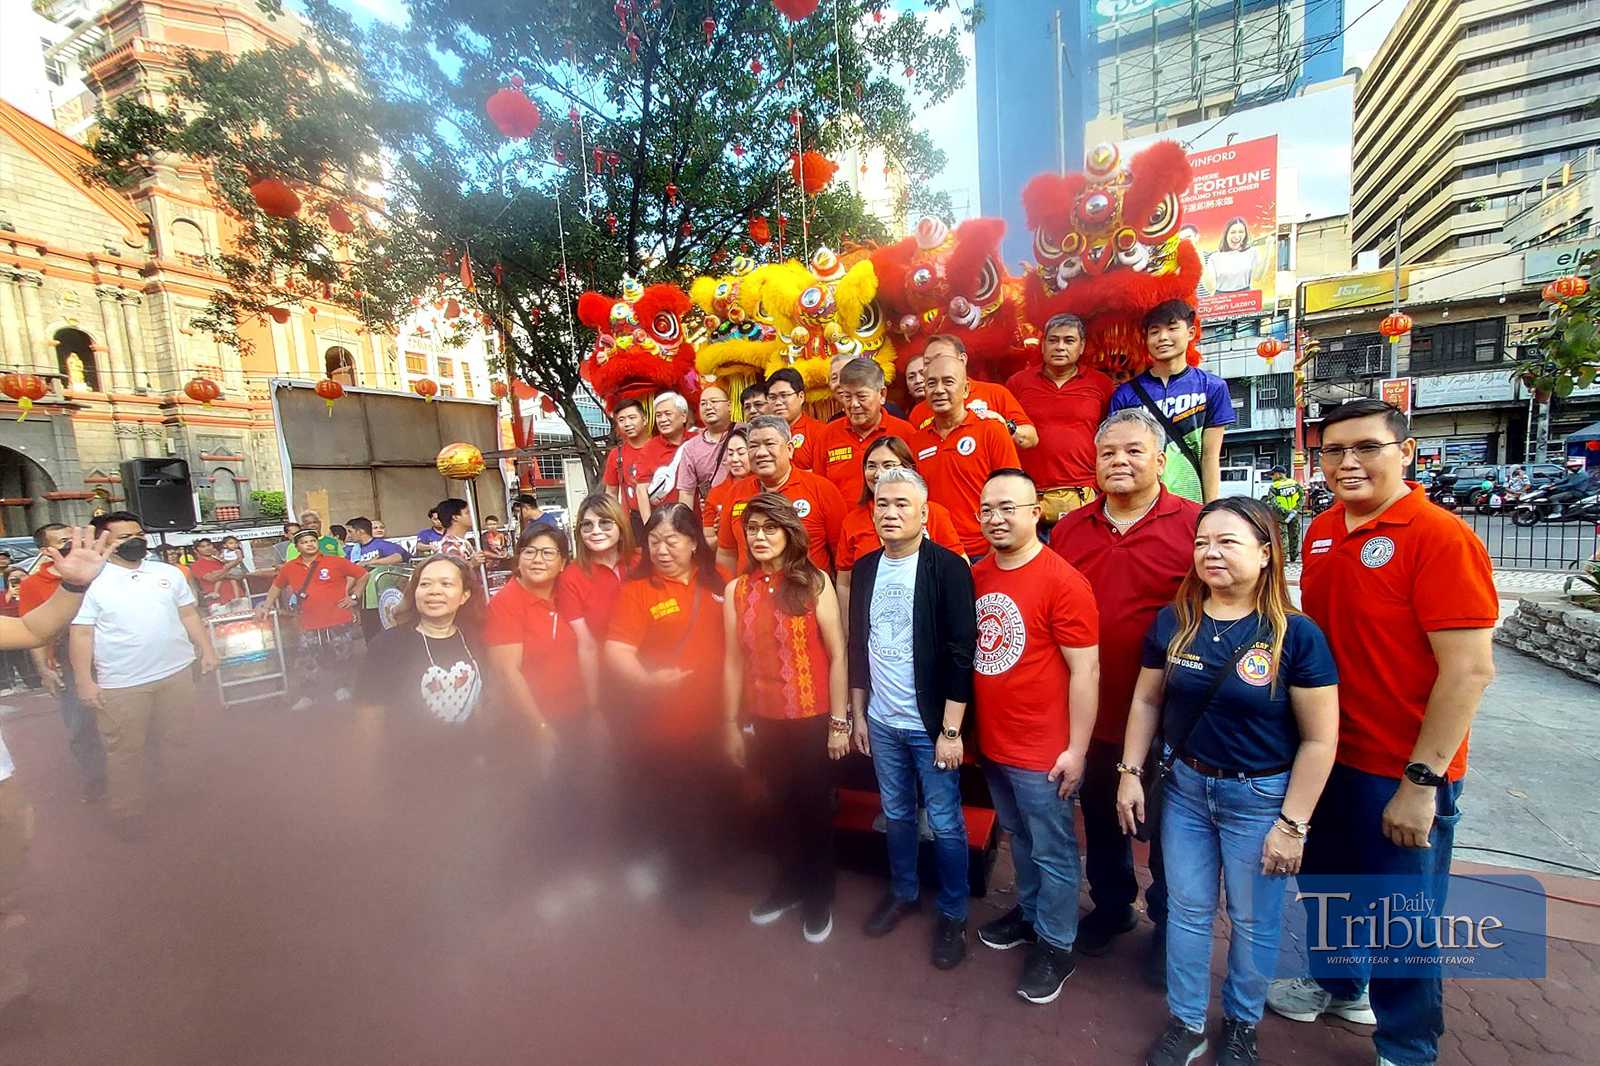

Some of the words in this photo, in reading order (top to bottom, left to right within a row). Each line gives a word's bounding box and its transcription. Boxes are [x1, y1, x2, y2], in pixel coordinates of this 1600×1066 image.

[1193, 168, 1271, 194] FORTUNE
[1214, 302, 1229, 312] San
[1230, 299, 1257, 310] Lazaro
[1181, 658, 1204, 671] OSERO
